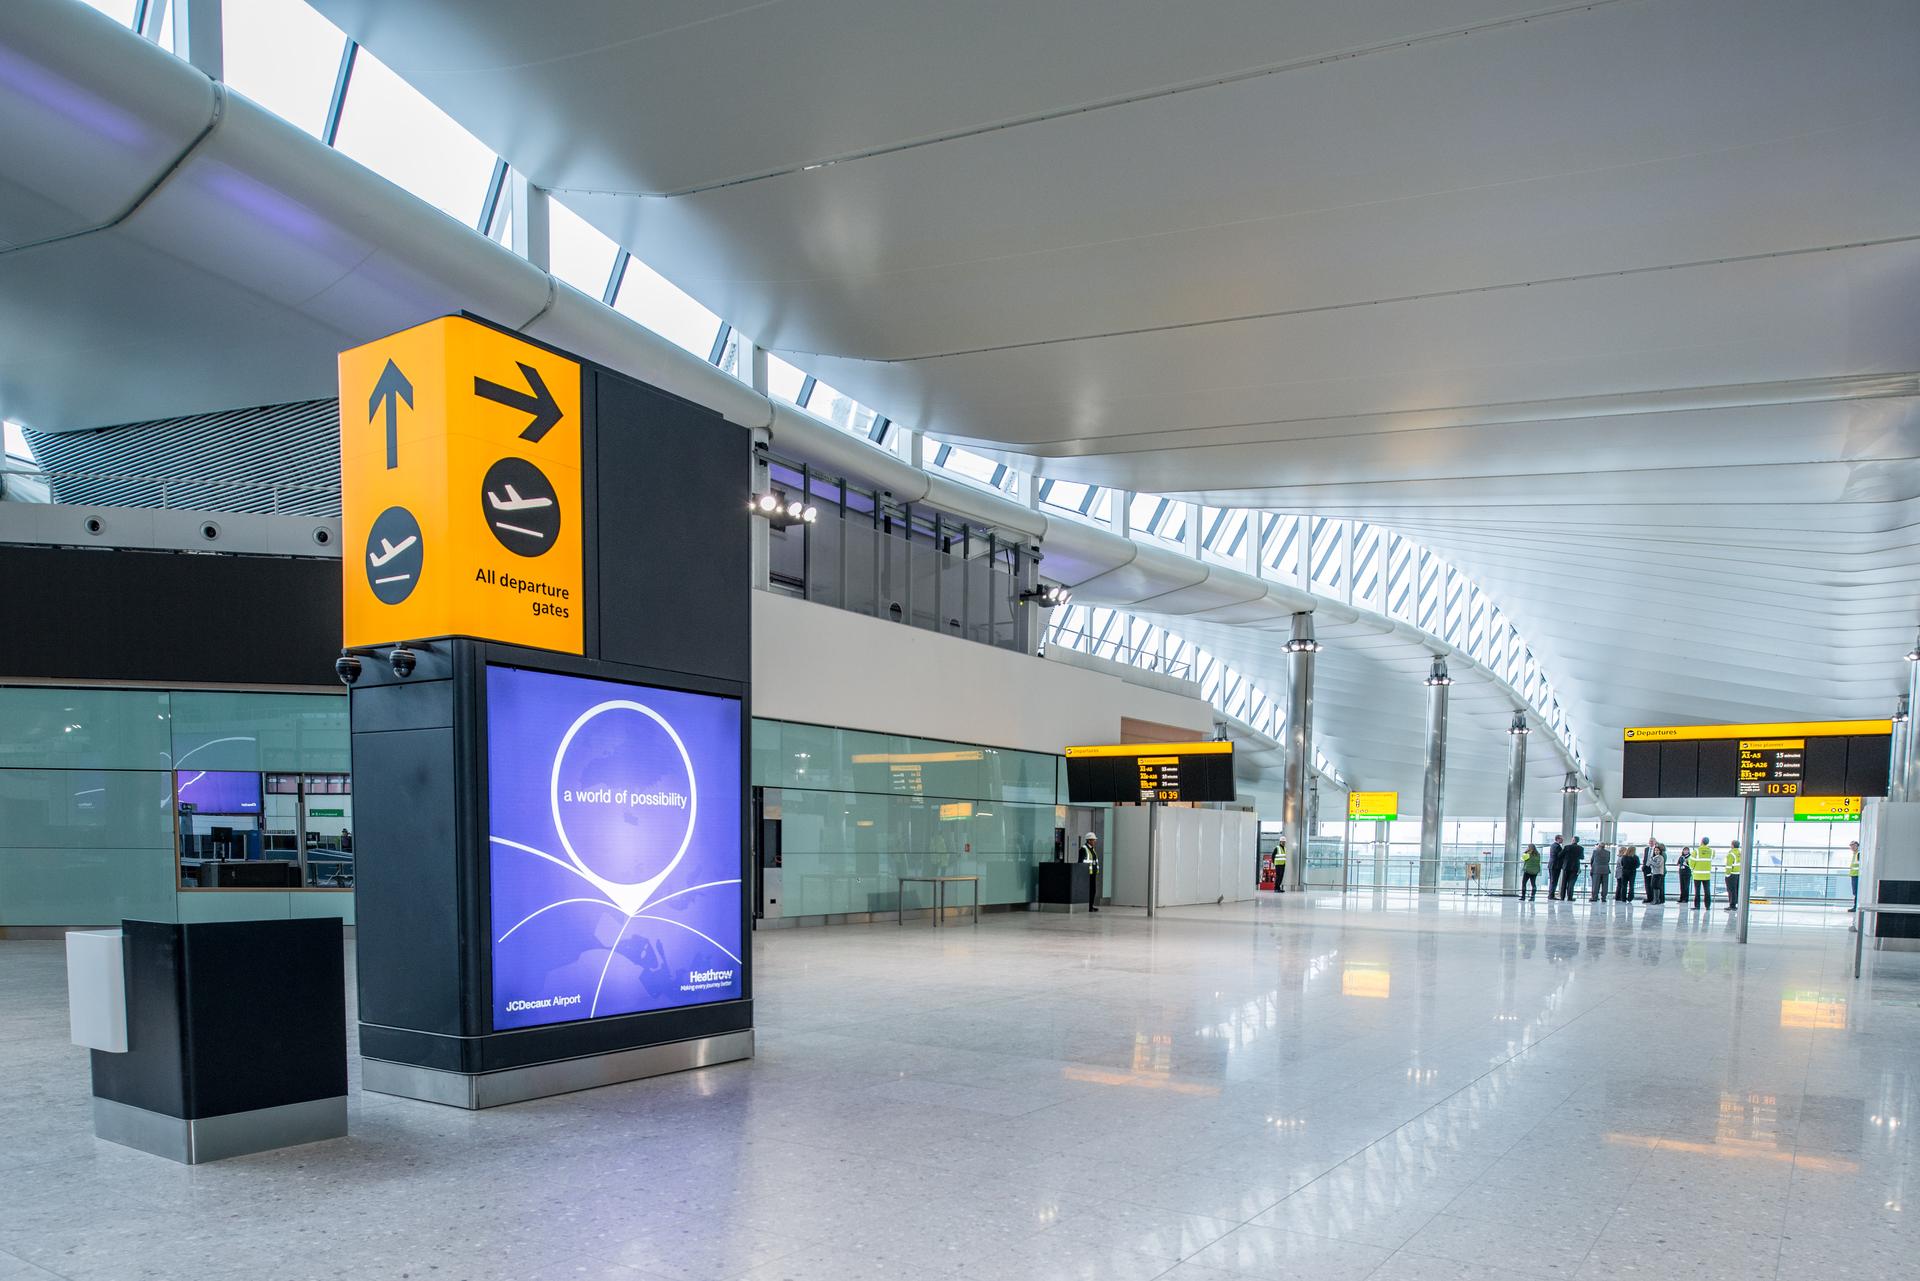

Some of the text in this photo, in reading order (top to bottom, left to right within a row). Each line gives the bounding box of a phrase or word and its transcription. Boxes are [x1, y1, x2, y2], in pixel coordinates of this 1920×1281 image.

[476, 568, 569, 600] All departure
[532, 601, 569, 618] gates
[1636, 729, 1677, 737] Departures
[1159, 791, 1167, 799] 10
[1168, 791, 1178, 799] 39
[1767, 784, 1780, 794] 10
[1782, 783, 1797, 794] 38
[563, 789, 687, 809] a world of possibility
[690, 968, 733, 983] Heathrow
[506, 994, 581, 1012] JCDecaux Airport
